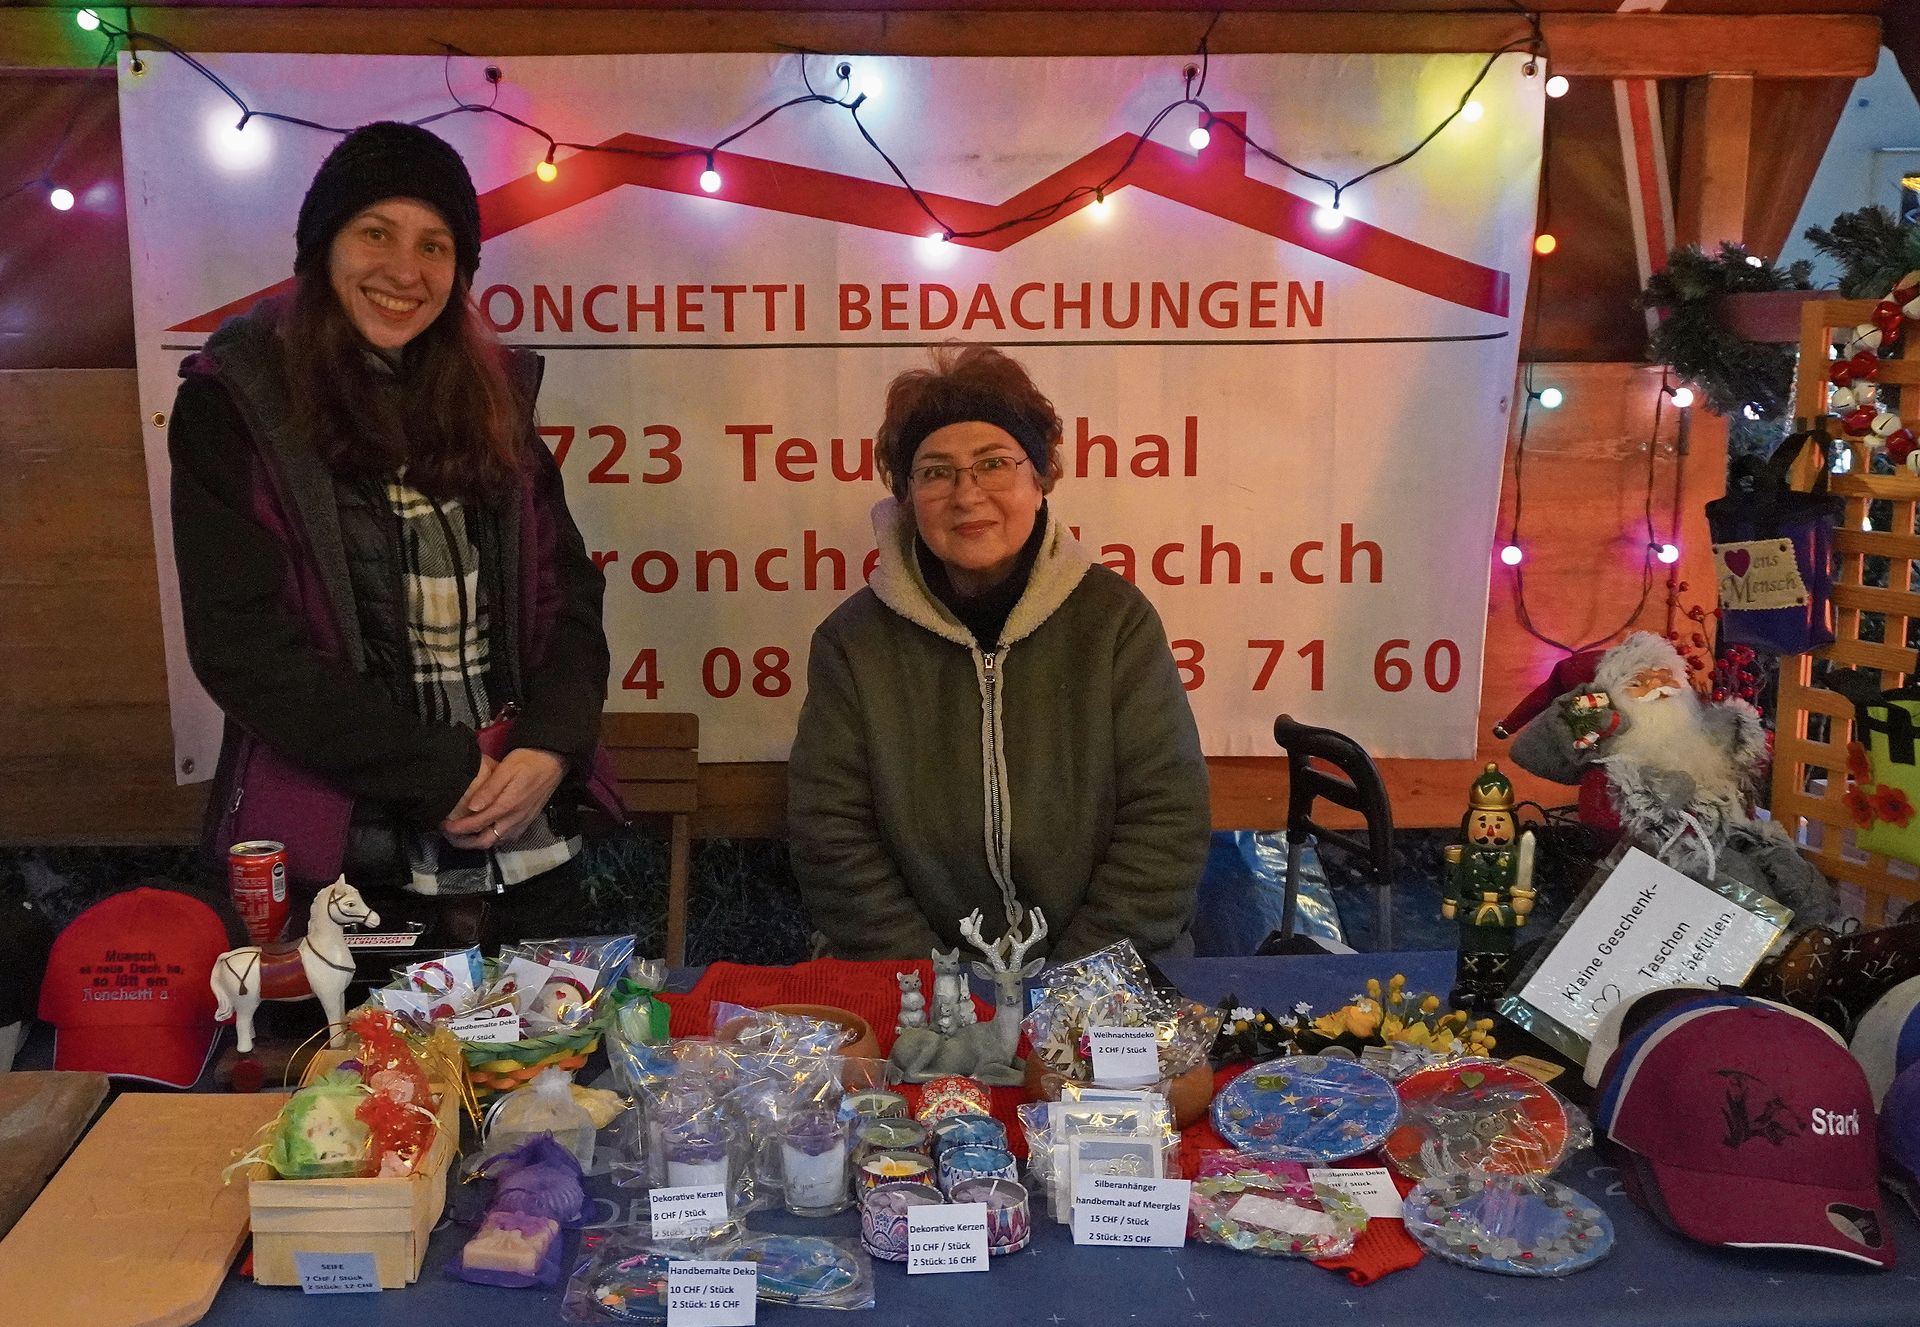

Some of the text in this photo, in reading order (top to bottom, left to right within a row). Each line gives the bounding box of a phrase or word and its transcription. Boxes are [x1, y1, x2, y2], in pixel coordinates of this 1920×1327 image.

[479, 280, 1325, 333] ONCHETTI BEDACHUNGEN
[538, 424, 683, 484] 723
[1721, 572, 1797, 603] Mensch
[702, 646, 792, 699] 08
[1247, 639, 1324, 691] 71
[1373, 638, 1462, 693] 60
[1562, 884, 1658, 1002] Kleine Geschenk-
[1638, 921, 1690, 978] Taschen
[451, 1022, 498, 1031] Handbemalte
[477, 1033, 496, 1041] Stück
[1093, 1031, 1155, 1039] Weihnachtsdeko
[1126, 1046, 1147, 1054] Stück
[1811, 1107, 1860, 1136] Stark
[1095, 1180, 1156, 1192] Silberanhänger
[652, 1191, 724, 1203] Dekorative Kerzen
[1076, 1196, 1181, 1211] handbemalt auf Meerglas
[661, 1211, 676, 1219] CHF
[685, 1209, 707, 1217] Stück
[1091, 1215, 1100, 1223] 15
[1102, 1215, 1118, 1223] CHF
[1126, 1217, 1149, 1226] Stück
[910, 1223, 985, 1233] Dekorative Kerzen
[1096, 1232, 1121, 1241] Stück:
[1123, 1234, 1133, 1242] 25
[1135, 1235, 1151, 1243] CHF
[910, 1244, 920, 1252] 10
[923, 1243, 940, 1251] CHF
[948, 1242, 971, 1250] Stück
[913, 1256, 977, 1266] 2 Stück: 16 CHF
[670, 1267, 756, 1276] Handbemalte Deko
[670, 1286, 681, 1294] 10
[683, 1286, 701, 1294] CHF
[710, 1285, 734, 1294] Stück
[680, 1300, 707, 1308] Stück:
